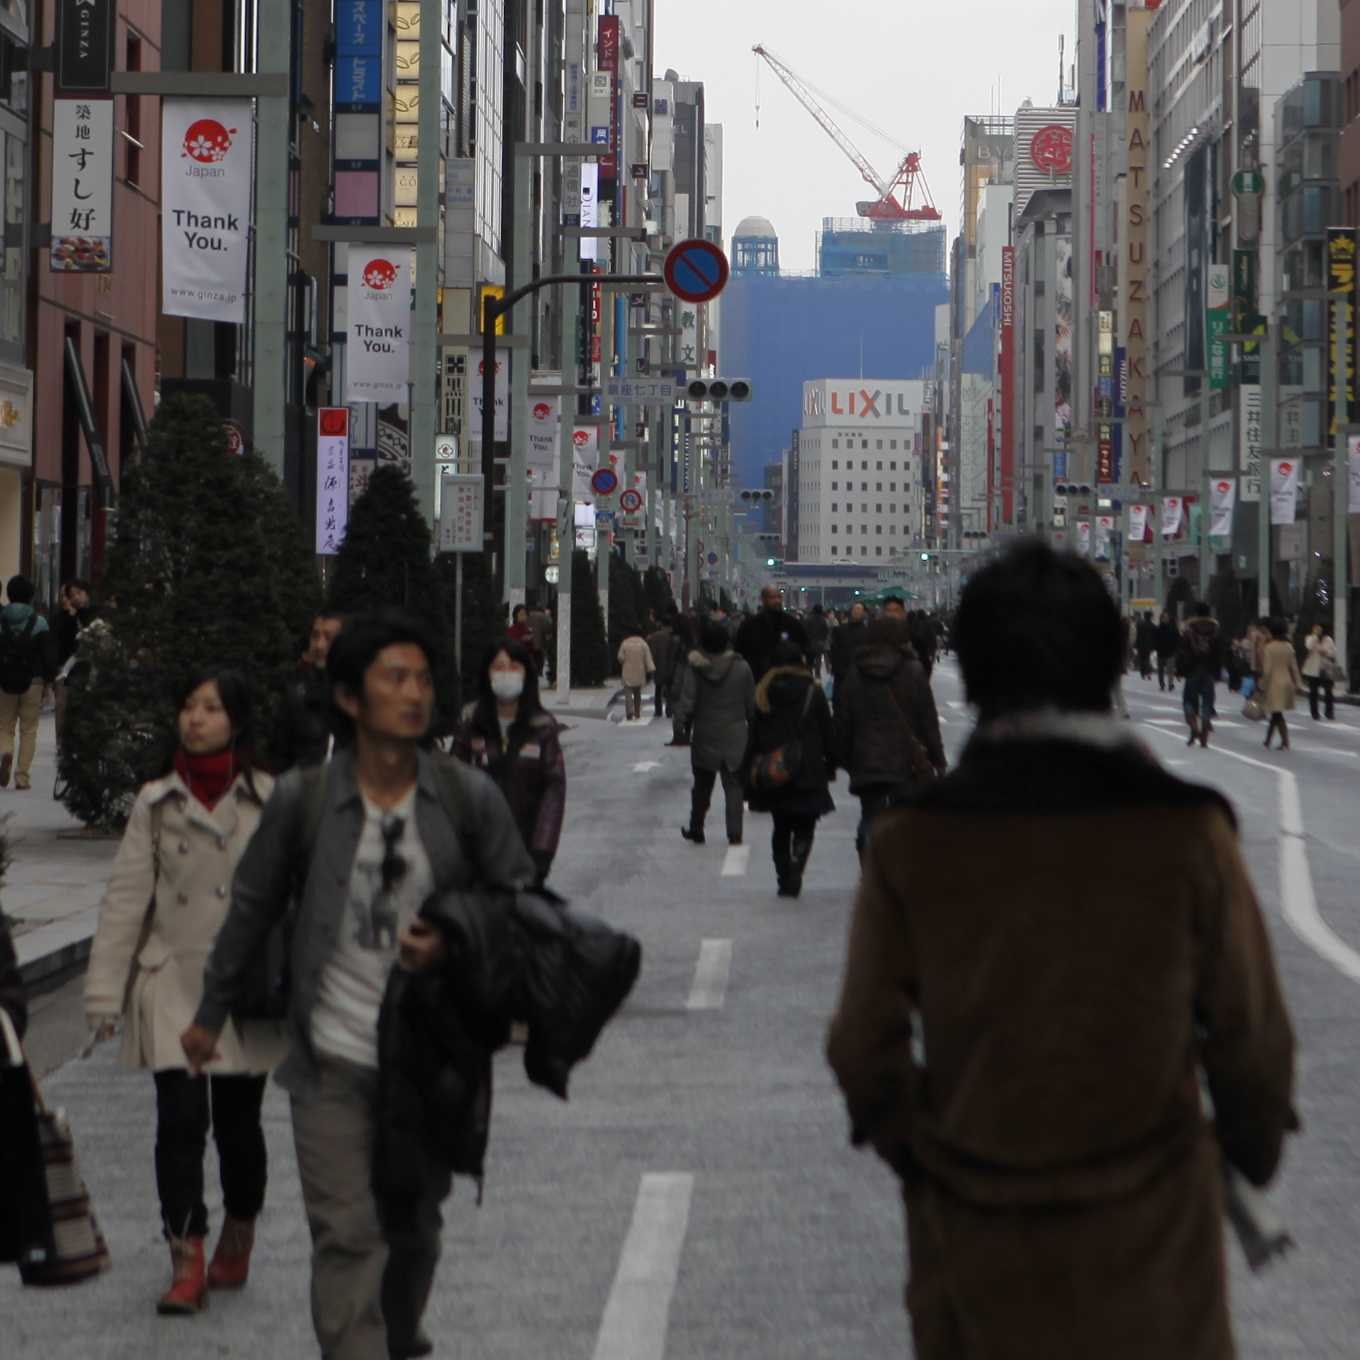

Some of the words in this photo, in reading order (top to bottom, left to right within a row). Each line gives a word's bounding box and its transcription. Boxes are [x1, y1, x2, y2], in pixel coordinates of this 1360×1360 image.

[80, 9, 90, 59] GINZA
[172, 210, 239, 231] Thank
[184, 232, 228, 253] You.
[1003, 252, 1013, 326] MITSUKOSHI
[1127, 90, 1145, 485] MATSUZAKAYA
[354, 324, 403, 338] Thank
[363, 340, 396, 354] You.
[473, 397, 504, 406] Thnk
[831, 390, 910, 417] LIXIL
